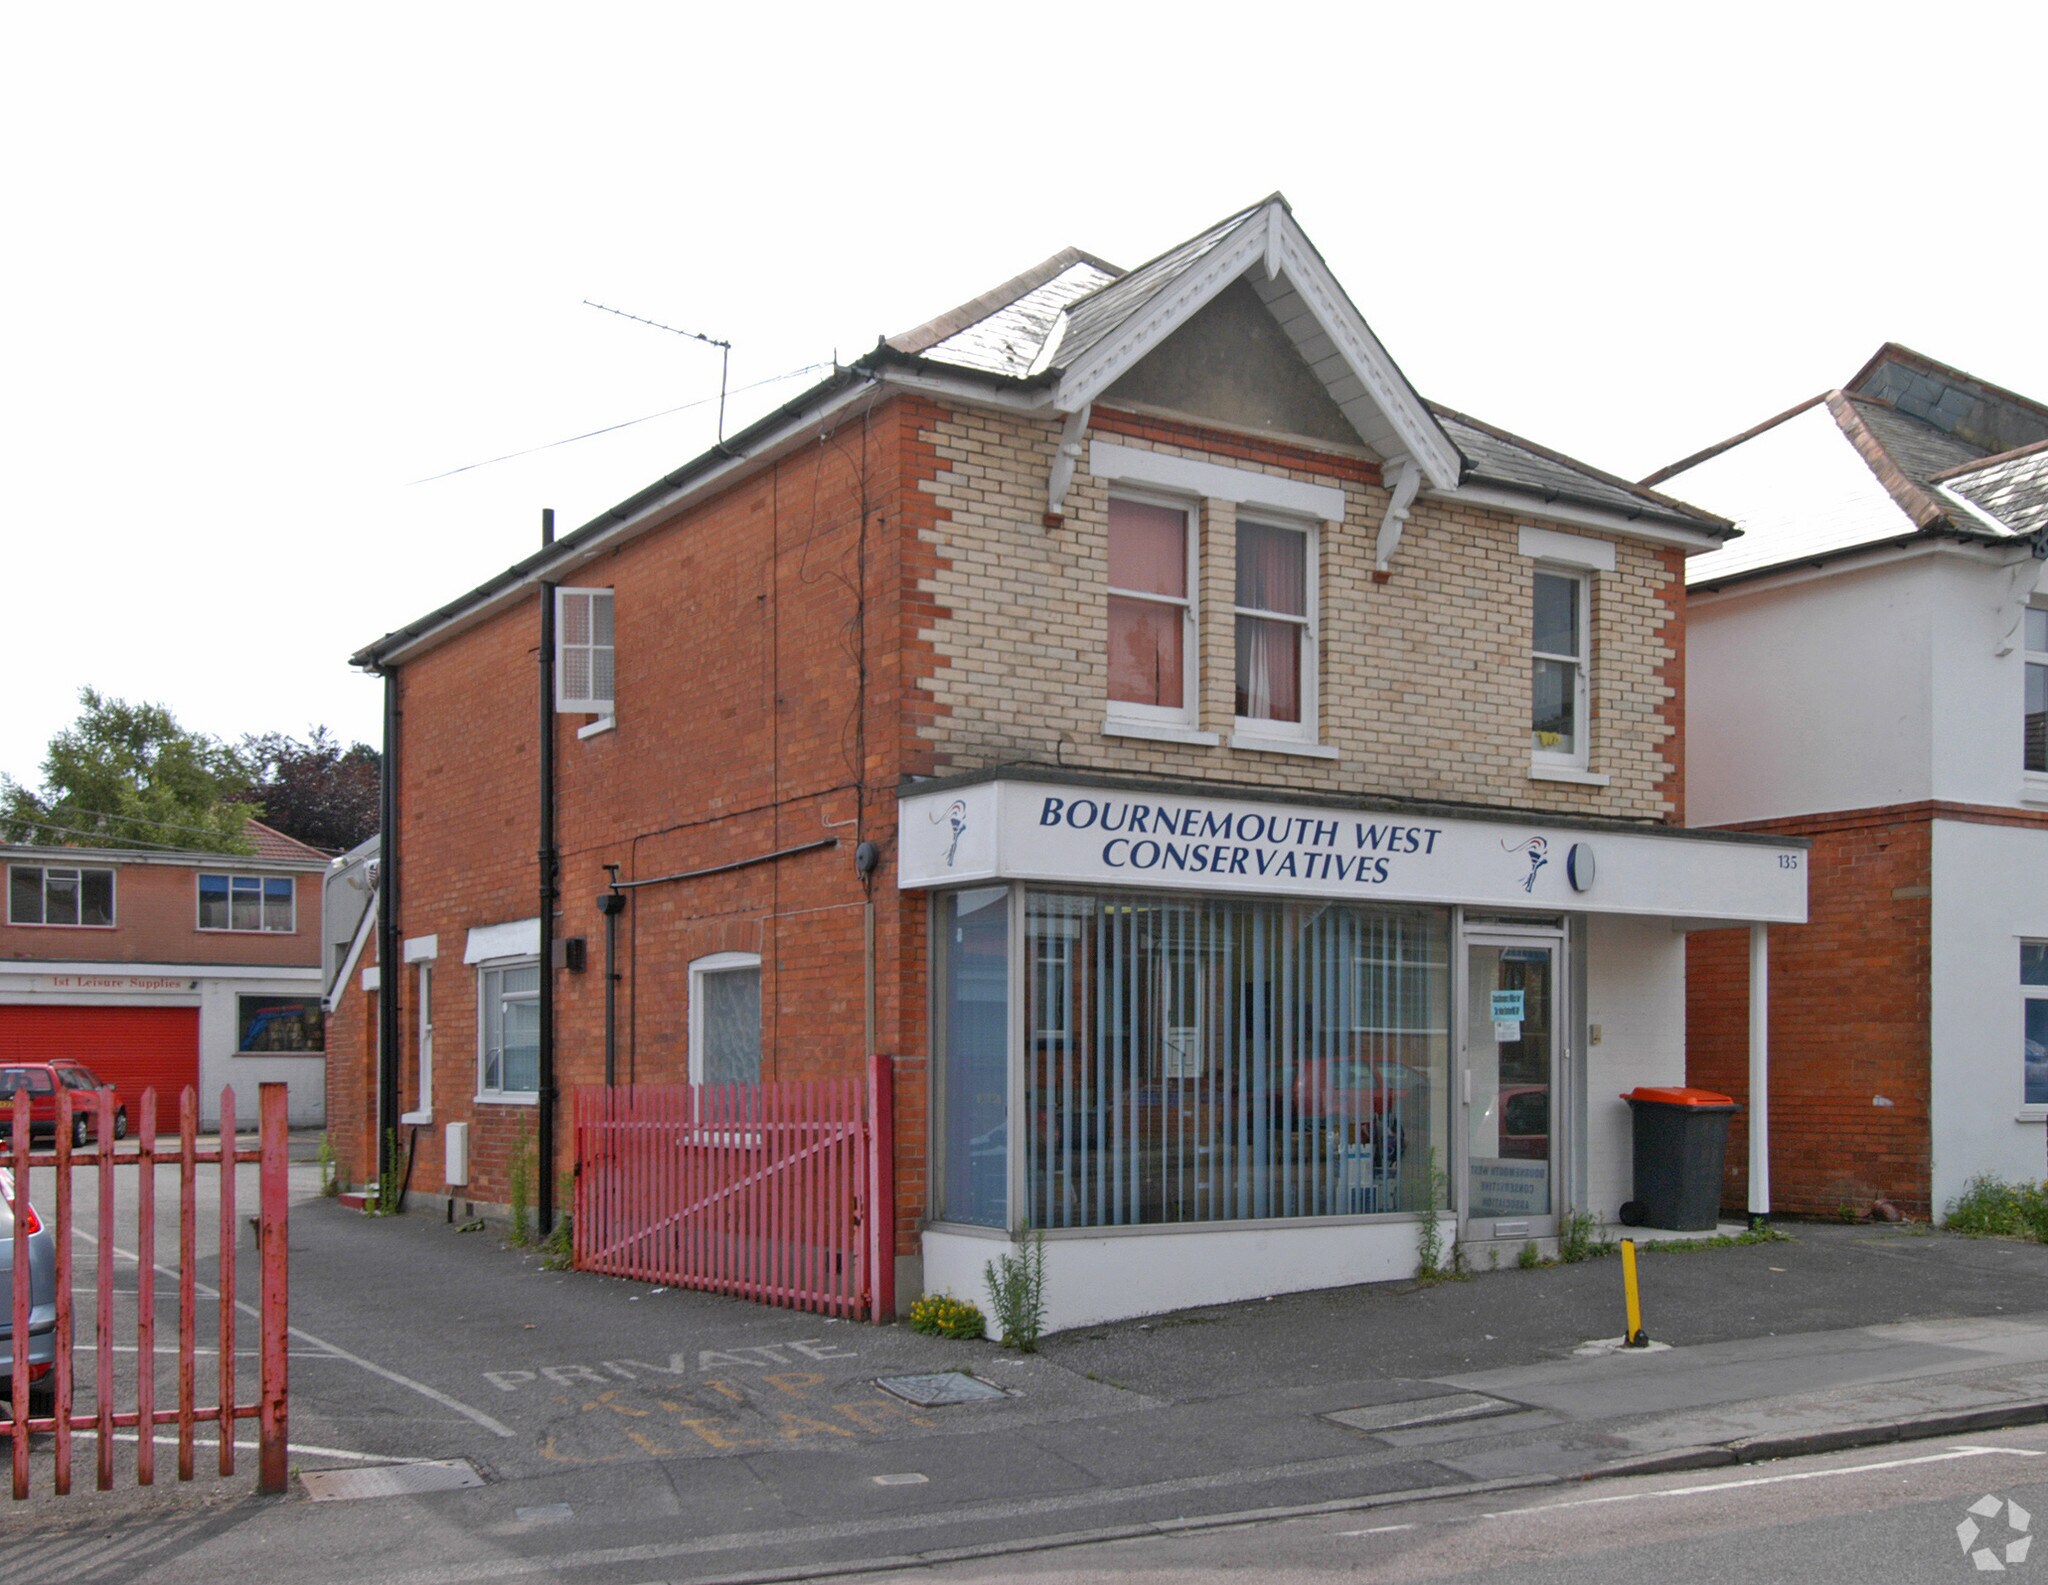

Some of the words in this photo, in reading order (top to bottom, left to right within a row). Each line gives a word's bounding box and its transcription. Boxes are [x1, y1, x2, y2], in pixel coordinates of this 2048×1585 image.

[1039, 796, 1340, 848] BOURNEMOUTH
[1355, 823, 1442, 855] WEST
[1101, 838, 1390, 884] CONSERVATIVES
[1777, 855, 1797, 870] 135
[77, 976, 123, 988] Leisure
[129, 977, 181, 990] Supplies
[482, 1338, 858, 1392] PRIVATE
